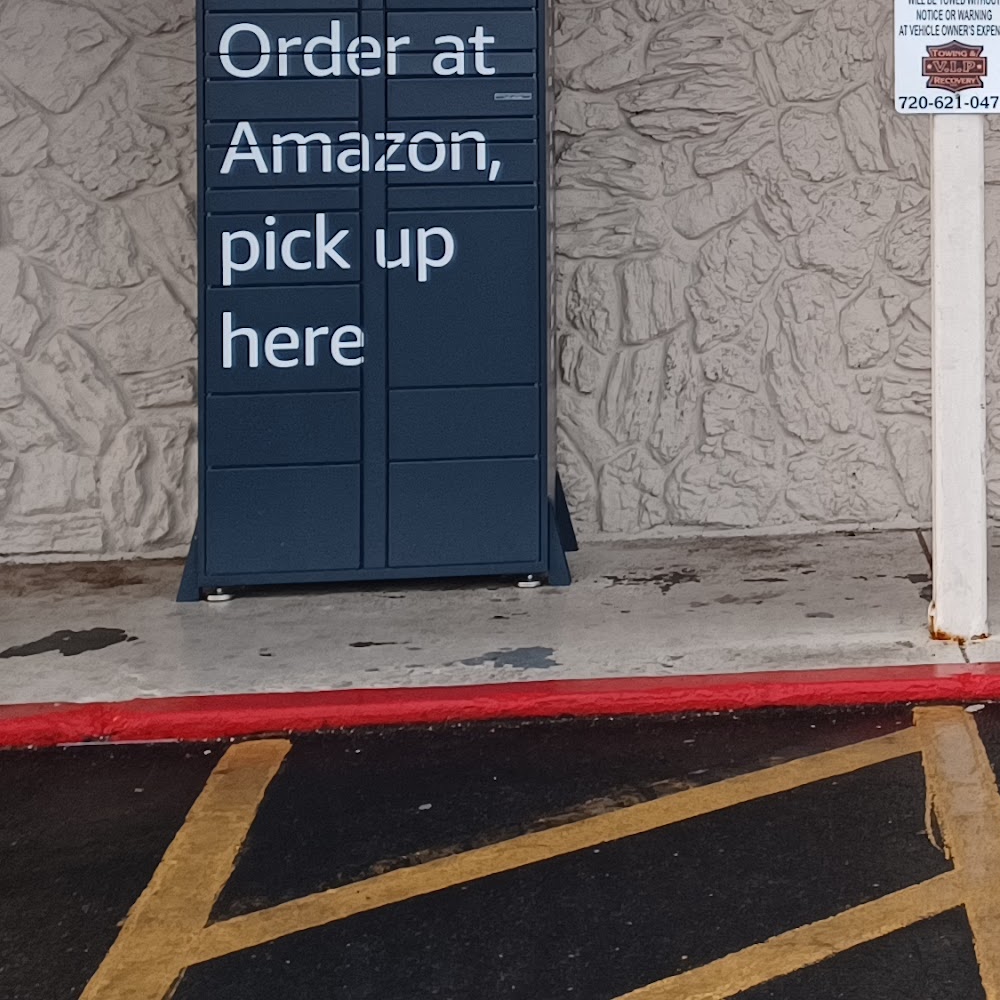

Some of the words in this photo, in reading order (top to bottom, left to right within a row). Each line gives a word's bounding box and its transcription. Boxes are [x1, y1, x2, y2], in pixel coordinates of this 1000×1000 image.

[899, 25, 909, 36] AT
[909, 25, 940, 36] VEHICLE
[941, 25, 975, 36] OWNER'S
[916, 9, 943, 21] NOTICE
[945, 9, 956, 21] OR
[957, 9, 993, 21] WARNING
[218, 19, 411, 79] Order
[431, 25, 497, 76] at
[220, 121, 501, 182] Amazon,
[221, 212, 351, 286] pick
[375, 224, 455, 282] up
[222, 311, 365, 369] here
